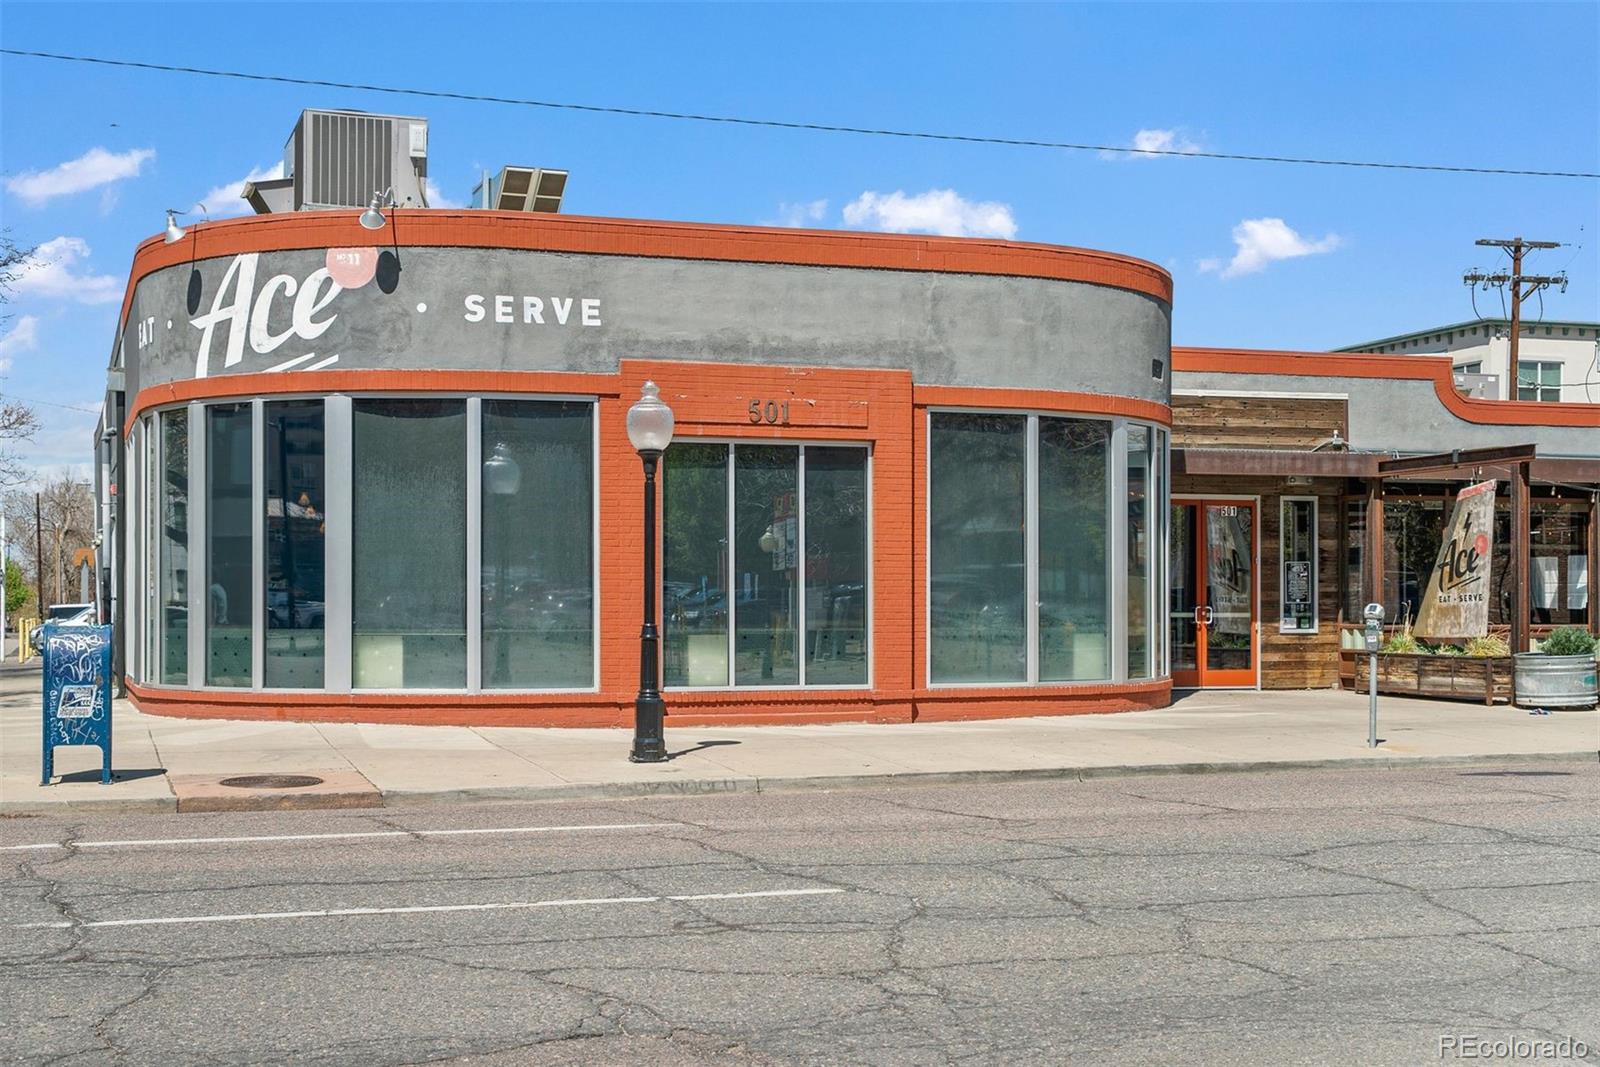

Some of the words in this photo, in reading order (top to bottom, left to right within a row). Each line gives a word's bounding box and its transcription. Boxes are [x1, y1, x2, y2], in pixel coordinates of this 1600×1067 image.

[189, 253, 344, 379] Ace
[464, 294, 602, 326] SERVE
[138, 316, 155, 350] EAT
[748, 399, 790, 425] 501
[1221, 505, 1238, 517] 501
[1437, 539, 1480, 593] Ace
[1438, 595, 1452, 603] EAT
[1458, 593, 1483, 603] SERVE
